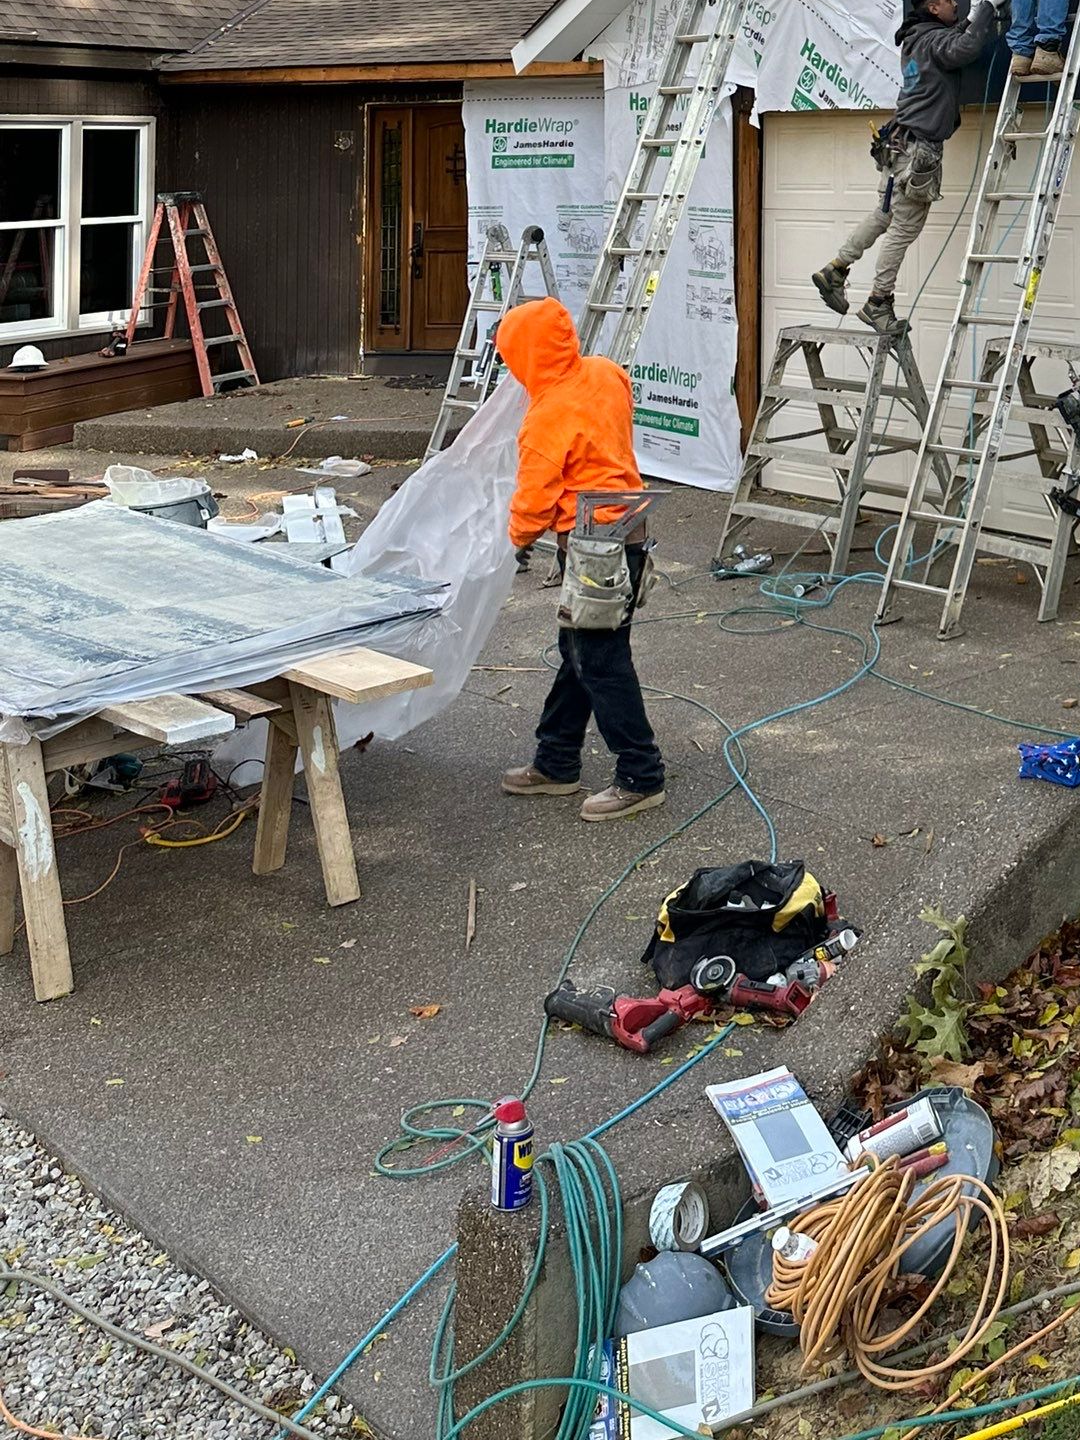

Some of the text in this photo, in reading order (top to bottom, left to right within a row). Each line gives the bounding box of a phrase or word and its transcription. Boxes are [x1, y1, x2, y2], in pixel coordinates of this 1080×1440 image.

[513, 140, 574, 149] JamesHardie
[495, 157, 531, 167] Engineered
[532, 156, 541, 166] for
[647, 390, 698, 409] JamesHardie
[664, 416, 672, 427] for
[622, 1365, 630, 1410] Flashg
[702, 1362, 721, 1422] SKIN
[718, 1359, 731, 1418] BEAR
